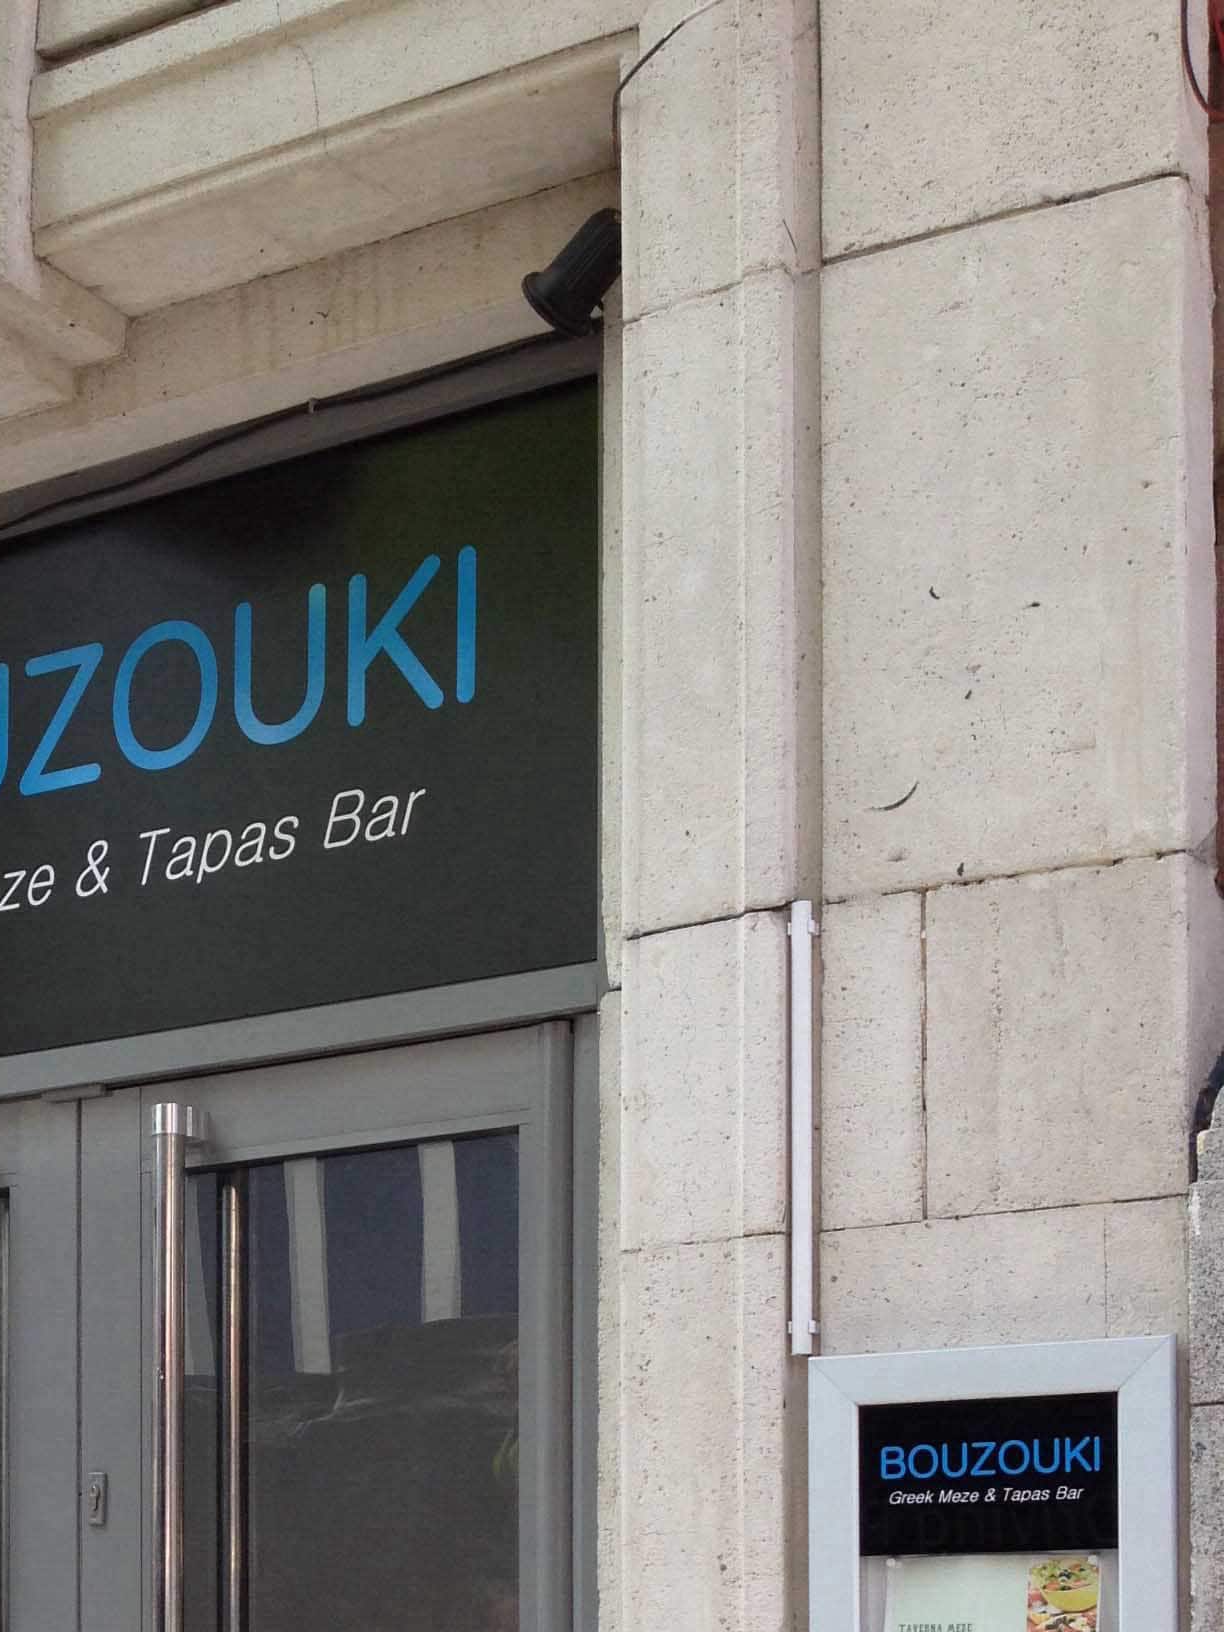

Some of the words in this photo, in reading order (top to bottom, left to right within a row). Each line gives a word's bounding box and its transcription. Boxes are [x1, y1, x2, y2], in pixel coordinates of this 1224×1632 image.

[75, 841, 111, 896] &
[140, 812, 300, 886] Tapas
[322, 783, 427, 850] Bar
[880, 1436, 1100, 1480] BOUZOUKI
[888, 1488, 934, 1505] Greek
[938, 1489, 980, 1504] Meze
[984, 1488, 997, 1502] &
[1002, 1486, 1050, 1503] Tapas
[1055, 1485, 1085, 1500] Bar
